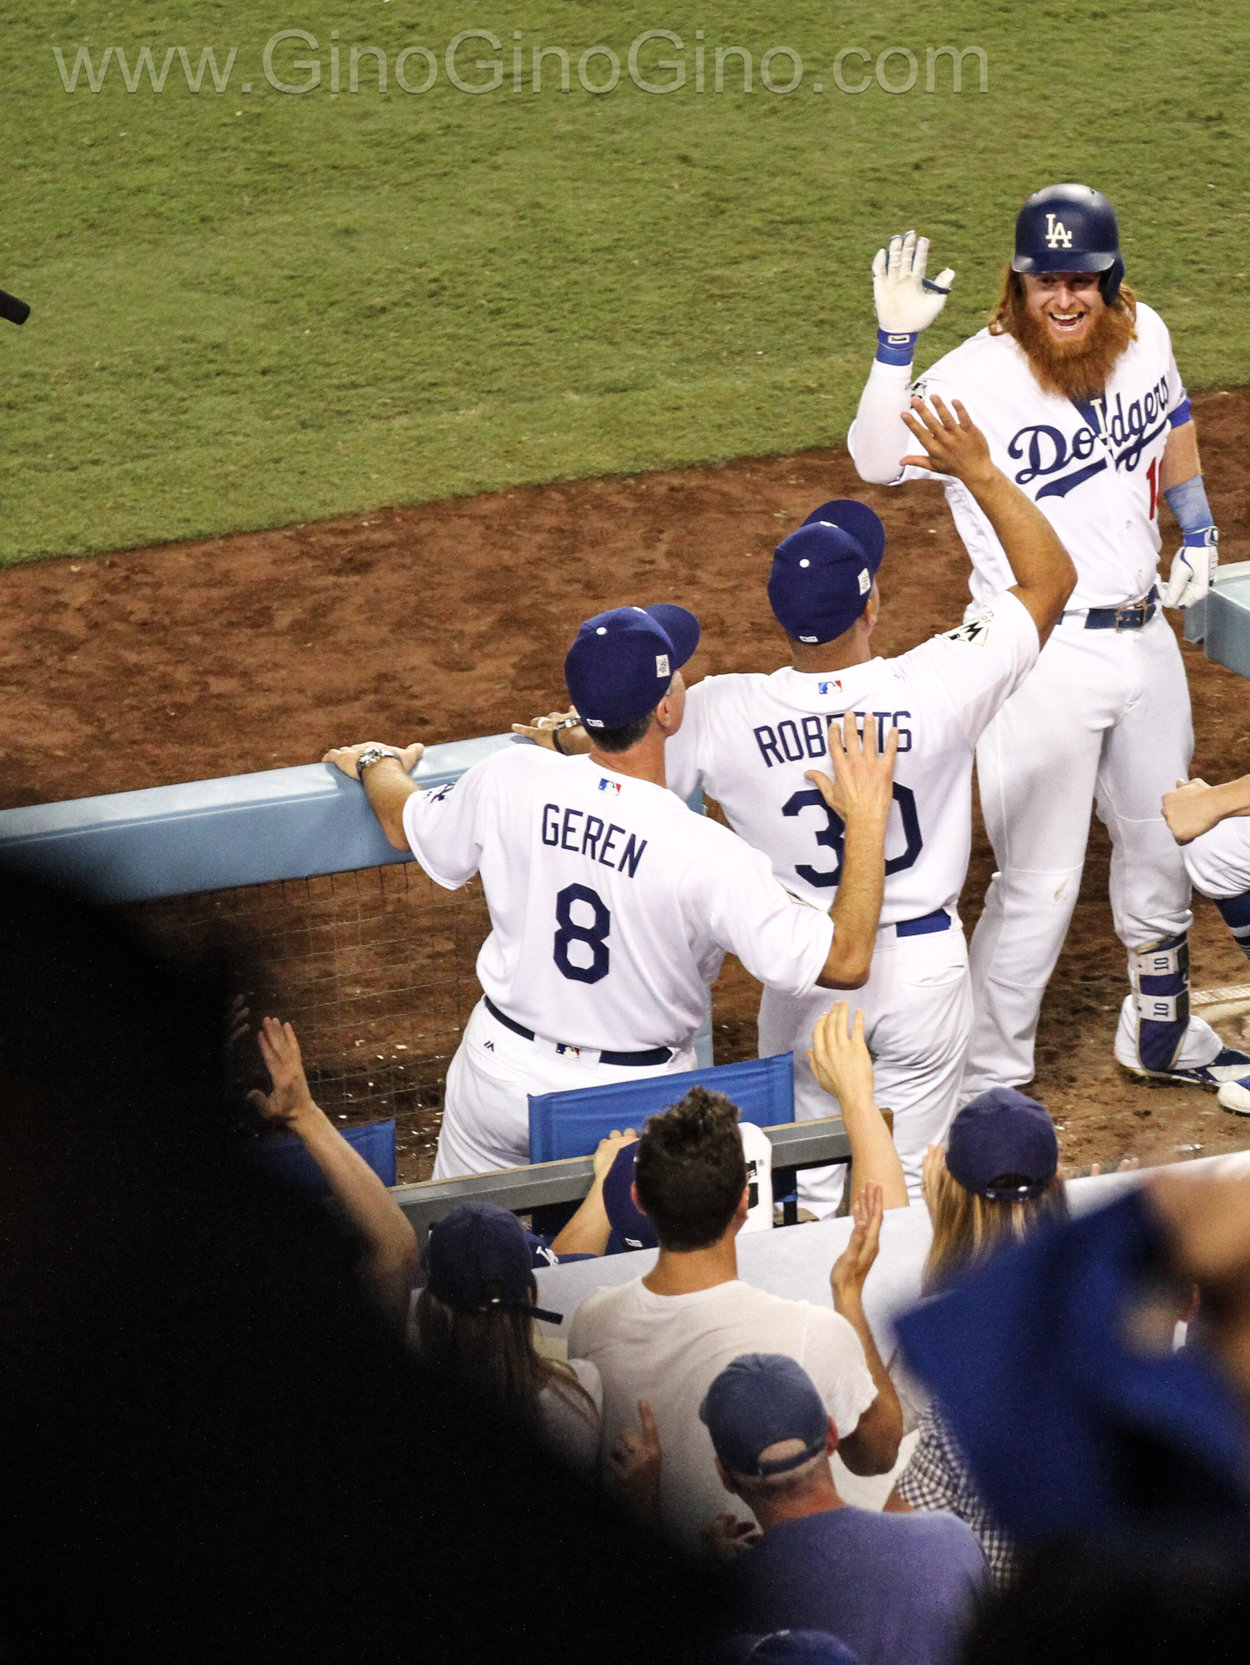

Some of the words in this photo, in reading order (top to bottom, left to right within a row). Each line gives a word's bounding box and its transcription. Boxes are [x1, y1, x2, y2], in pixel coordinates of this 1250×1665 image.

[1045, 213, 1073, 249] LA
[1007, 374, 1170, 485] Dodgers
[541, 803, 649, 880] GEREN
[553, 882, 611, 985] 8
[1153, 956, 1170, 971] 10
[1153, 1002, 1170, 1018] 10
